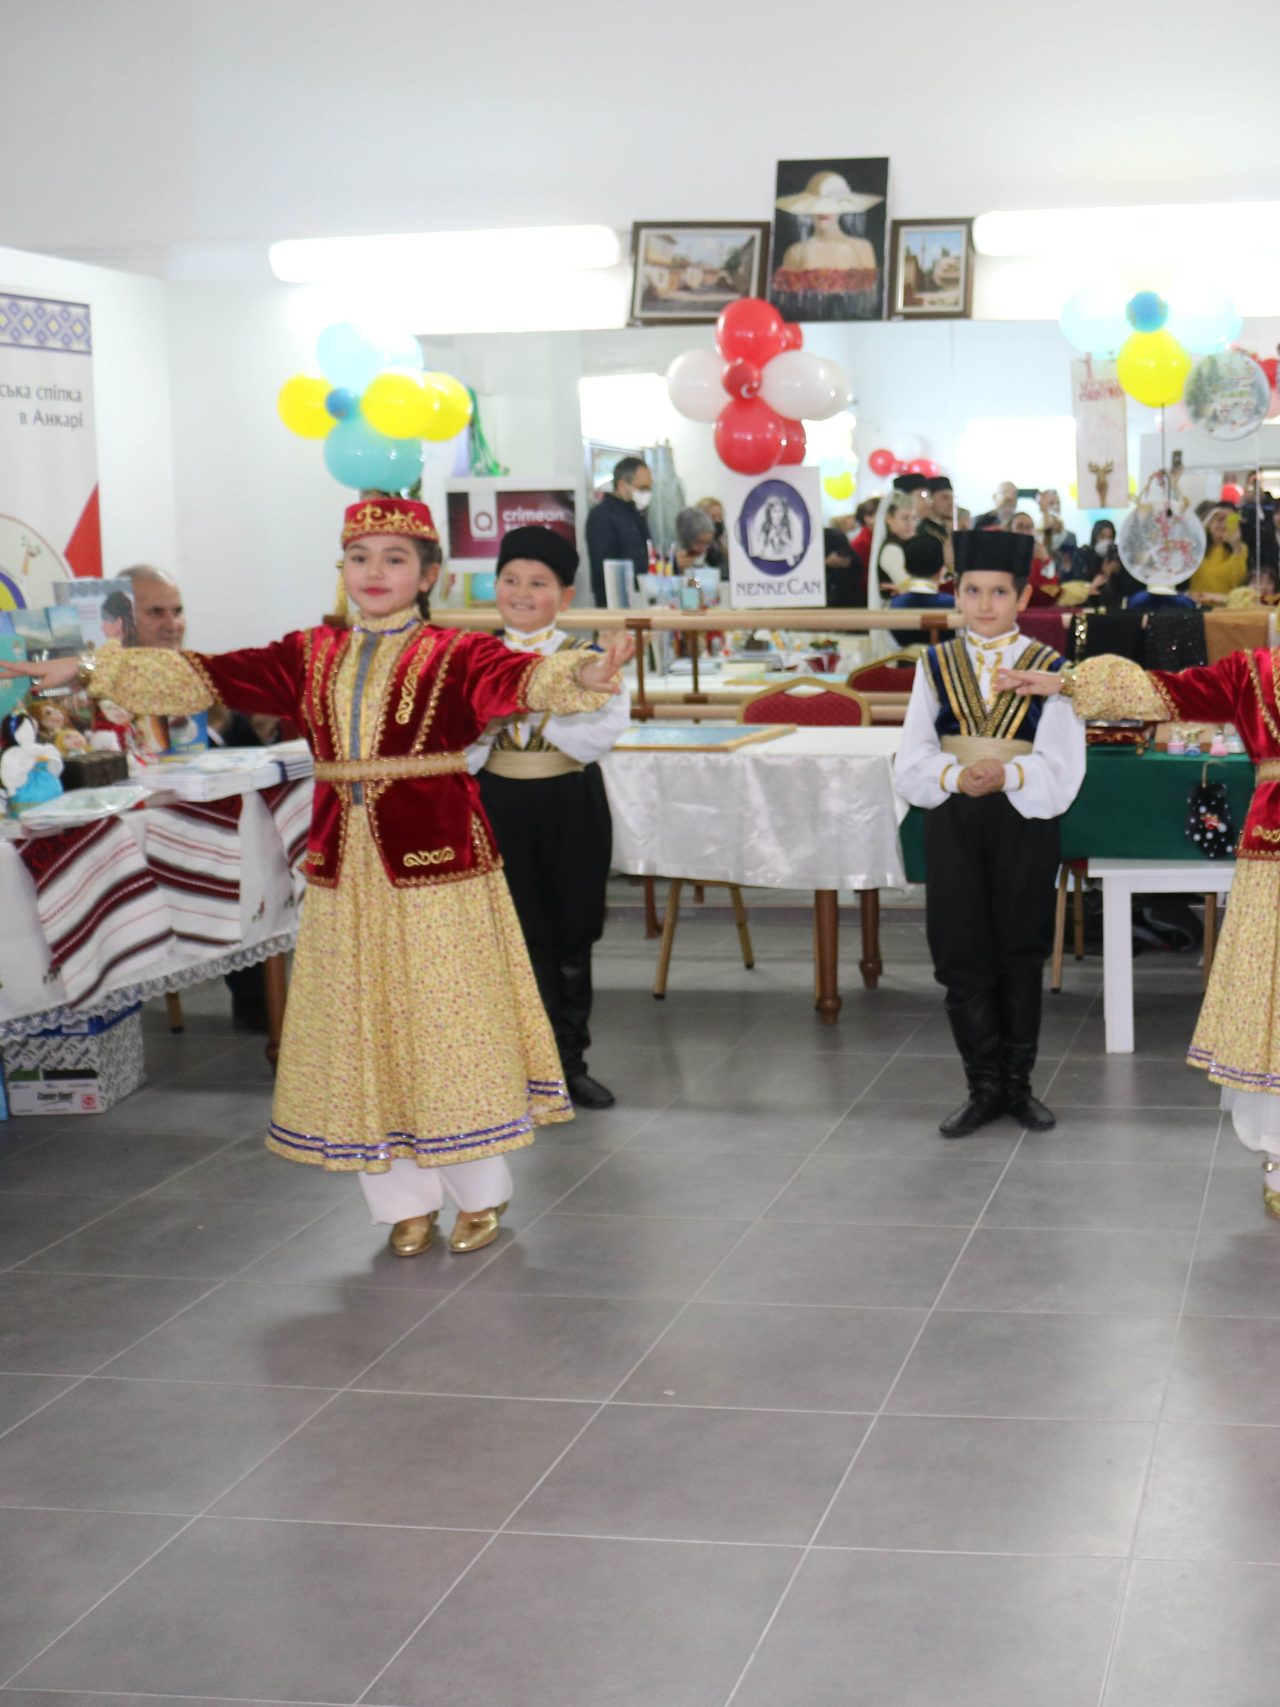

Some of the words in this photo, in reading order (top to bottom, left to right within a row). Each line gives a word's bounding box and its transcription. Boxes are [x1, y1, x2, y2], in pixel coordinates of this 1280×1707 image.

[36, 384, 81, 402] спілка
[20, 411, 27, 425] в
[33, 409, 82, 431] Анкарі
[503, 507, 565, 522] crimean
